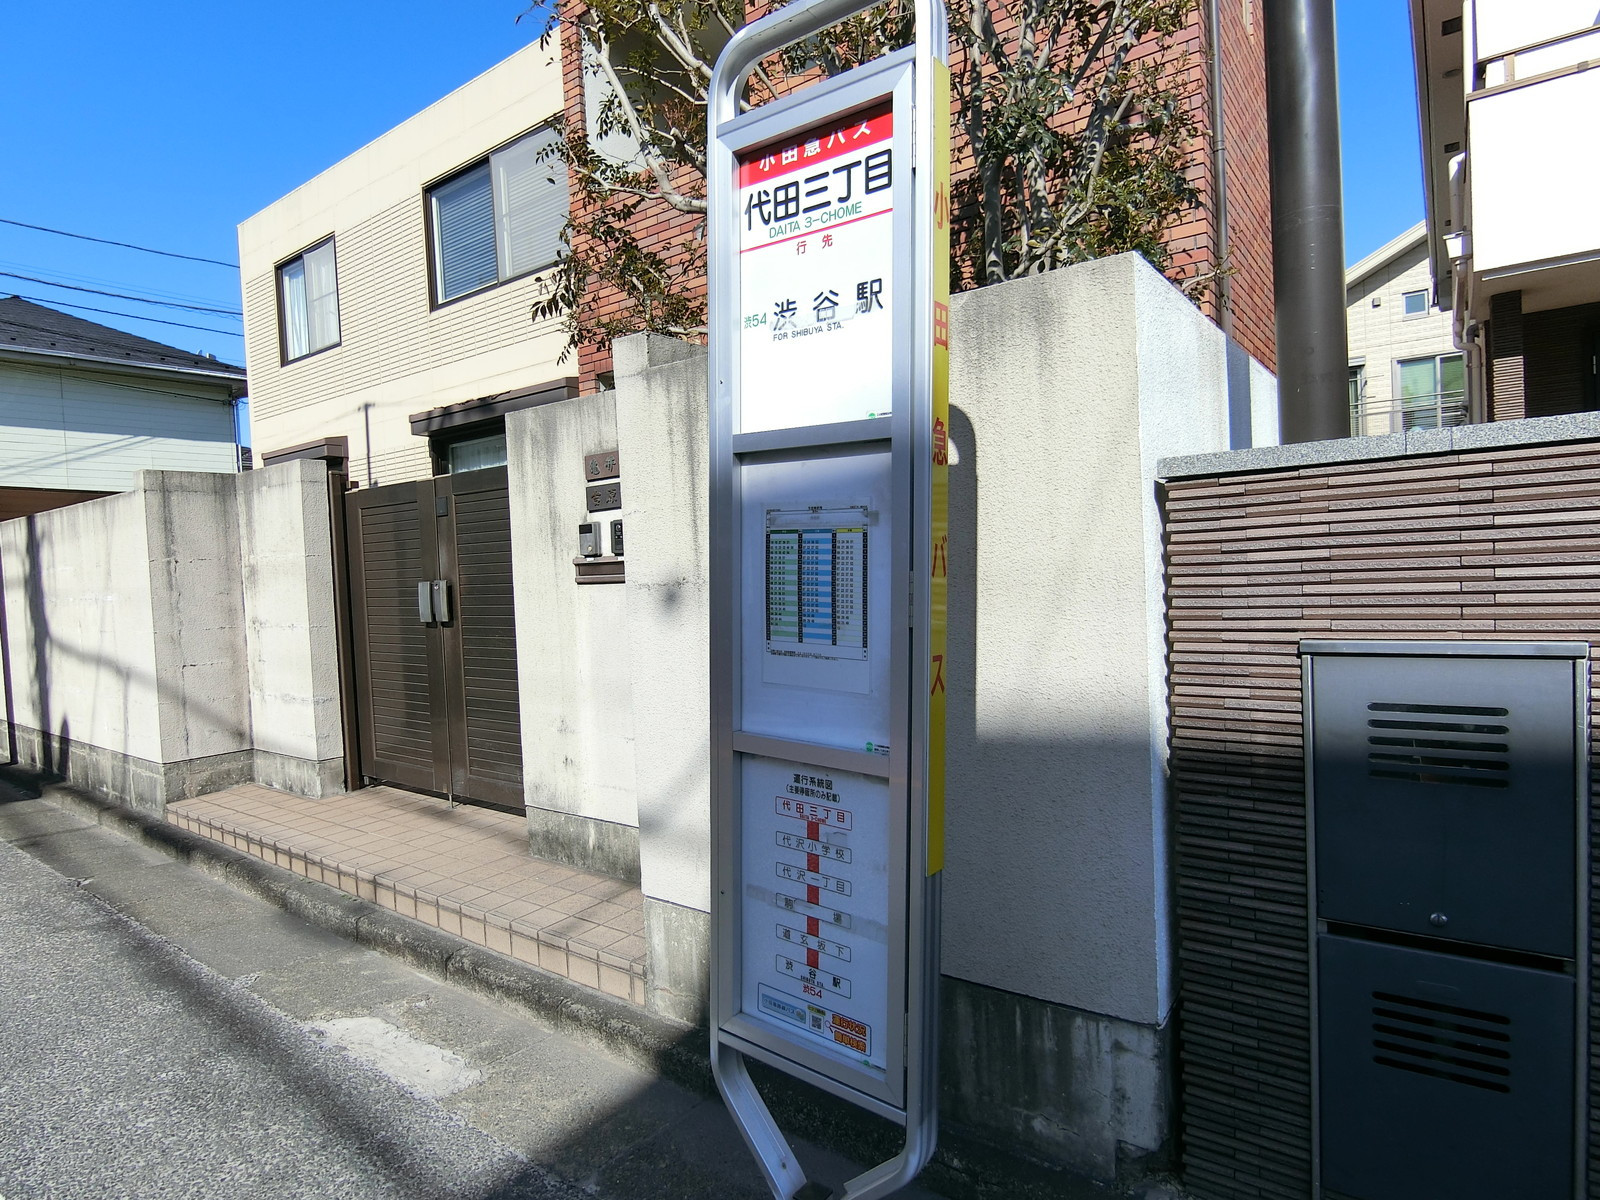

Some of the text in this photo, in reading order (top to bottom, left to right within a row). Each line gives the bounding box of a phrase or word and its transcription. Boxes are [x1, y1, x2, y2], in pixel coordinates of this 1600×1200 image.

[759, 119, 871, 172] 小田急バス
[744, 149, 892, 231] 代田三丁目
[769, 201, 862, 239] DAITA 3-CHOME
[796, 234, 833, 255] 行先
[772, 278, 884, 331] 渋谷駅
[744, 312, 767, 329] 渋54
[773, 322, 844, 342] FOR SHIBUYA STA.
[932, 180, 950, 698] 小田急バス
[793, 774, 832, 790] 運行系統図
[783, 800, 844, 823] 代田三丁目
[783, 835, 844, 860] 代沢小学校
[783, 866, 845, 892] 代沢一丁目
[782, 929, 844, 957] 道玄坂下
[785, 959, 841, 989] 渋谷駅
[803, 984, 822, 999] 渋54
[832, 1013, 867, 1037] 運行状況
